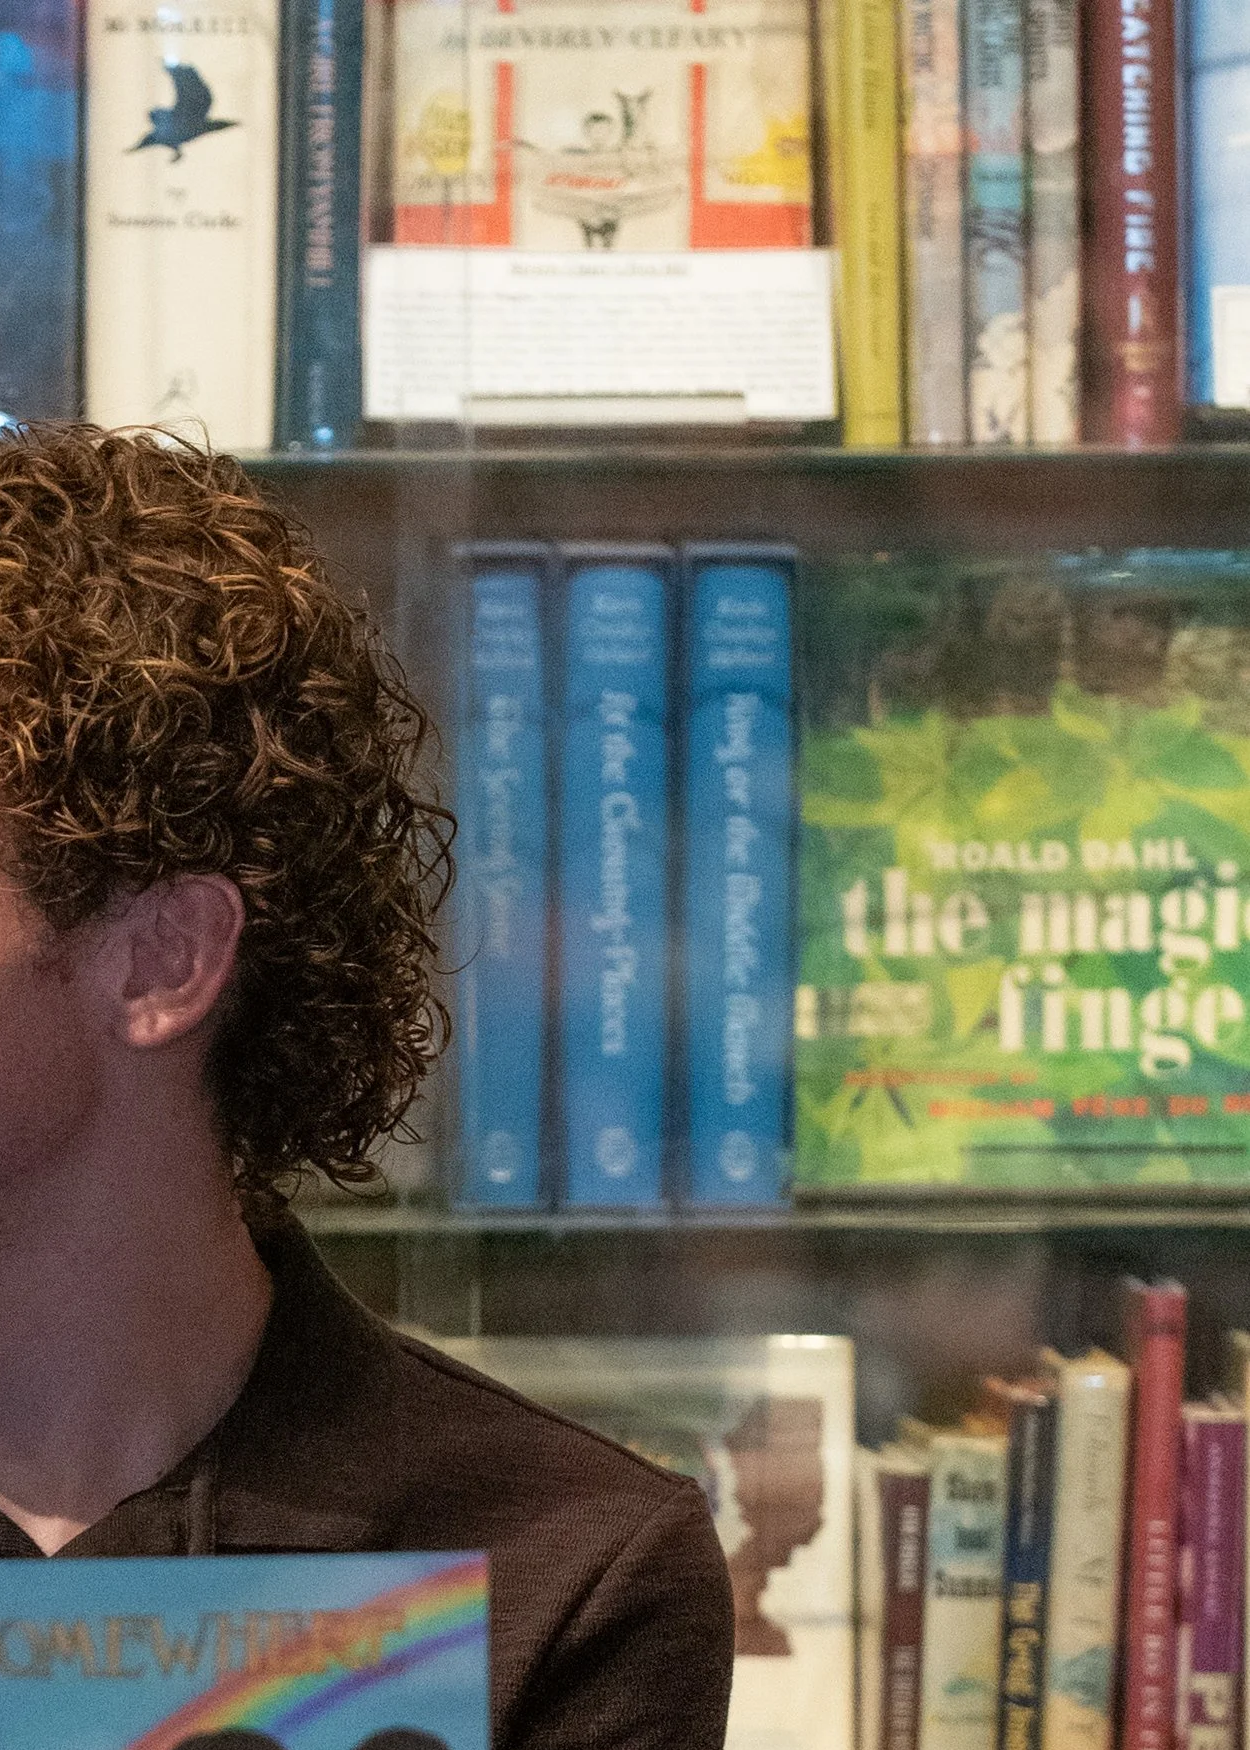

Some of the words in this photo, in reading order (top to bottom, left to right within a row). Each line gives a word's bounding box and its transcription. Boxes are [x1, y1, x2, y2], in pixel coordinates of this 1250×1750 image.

[927, 838, 1069, 872] ROALD
[1080, 838, 1196, 872] DAHL
[842, 867, 989, 956] the
[1018, 858, 1250, 976] magi
